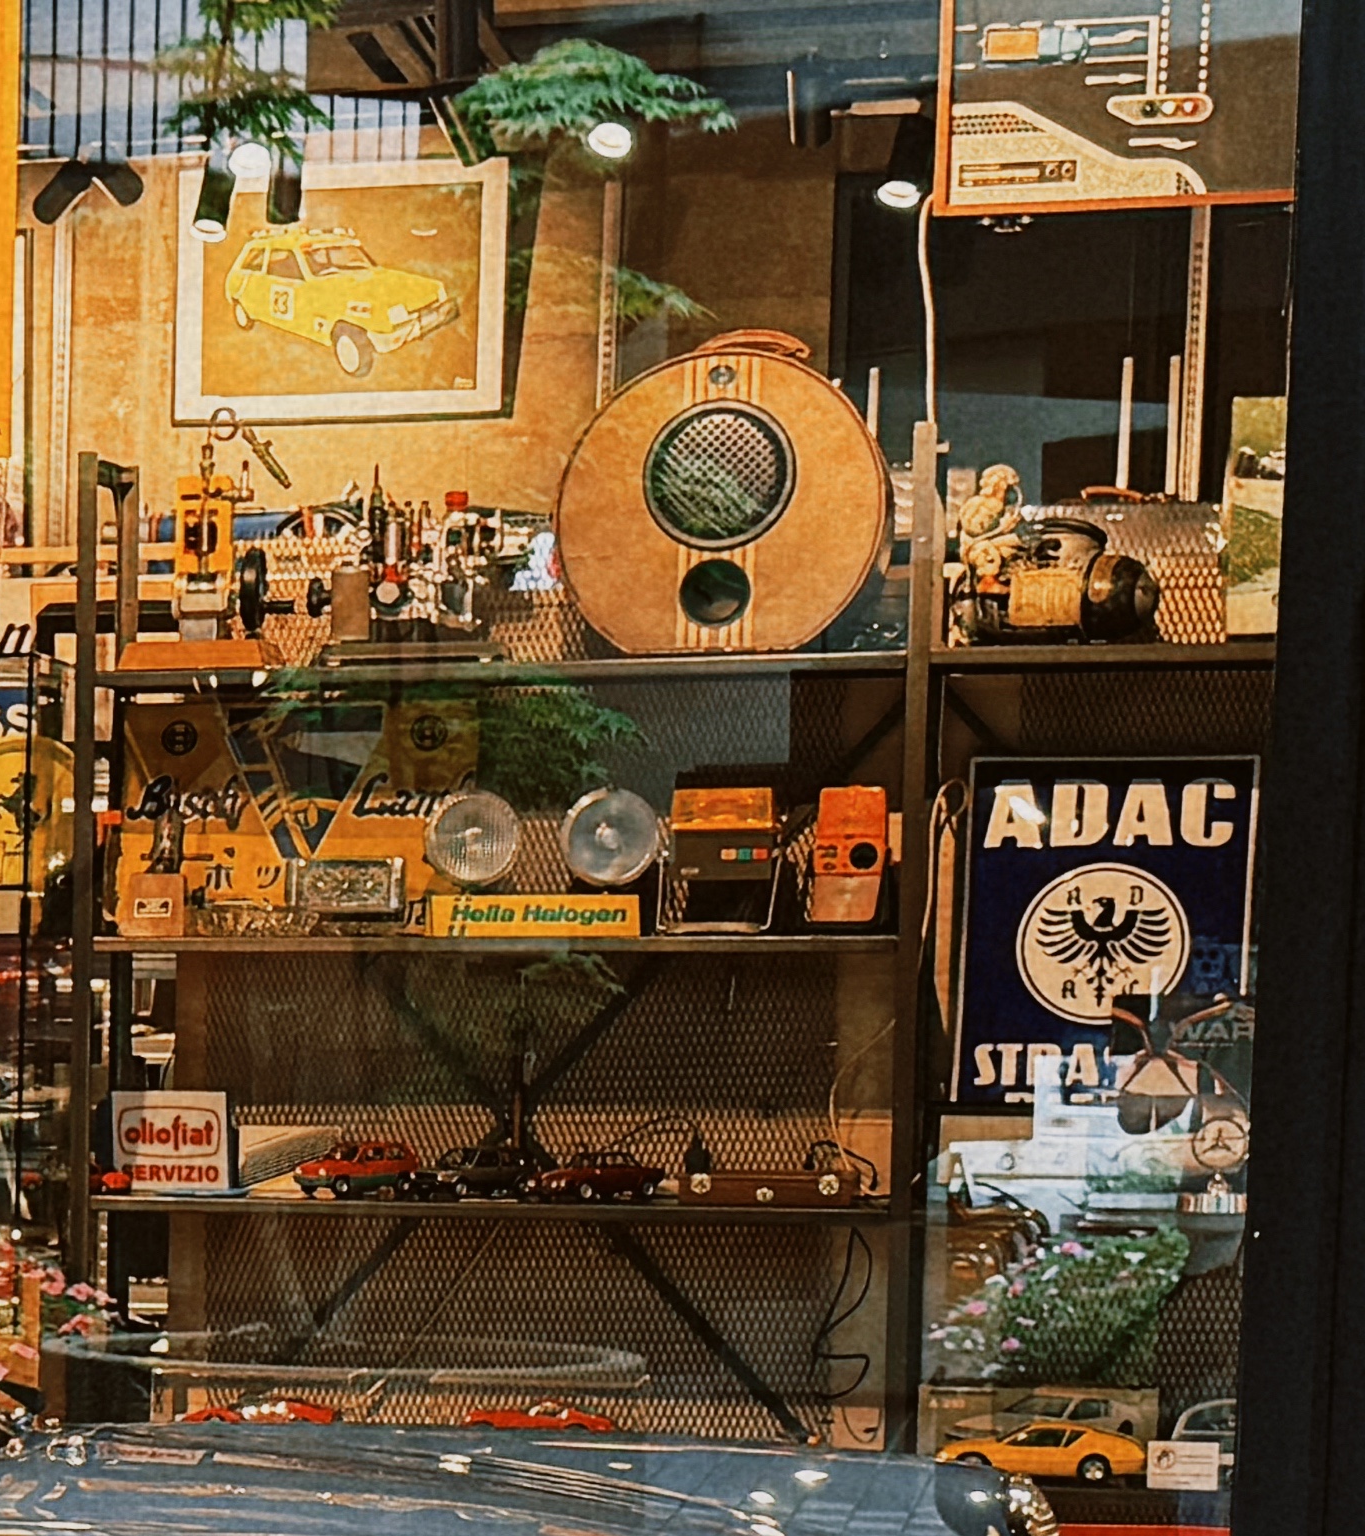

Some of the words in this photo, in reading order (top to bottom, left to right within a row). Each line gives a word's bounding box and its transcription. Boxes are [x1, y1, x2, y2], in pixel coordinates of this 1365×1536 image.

[983, 779, 1237, 848] ADAC
[450, 902, 516, 922] Hella
[521, 902, 627, 925] Halogen
[973, 1043, 1115, 1087] STRA
[124, 1114, 215, 1151] oliofiat
[121, 1163, 220, 1183] SERVIZIO
